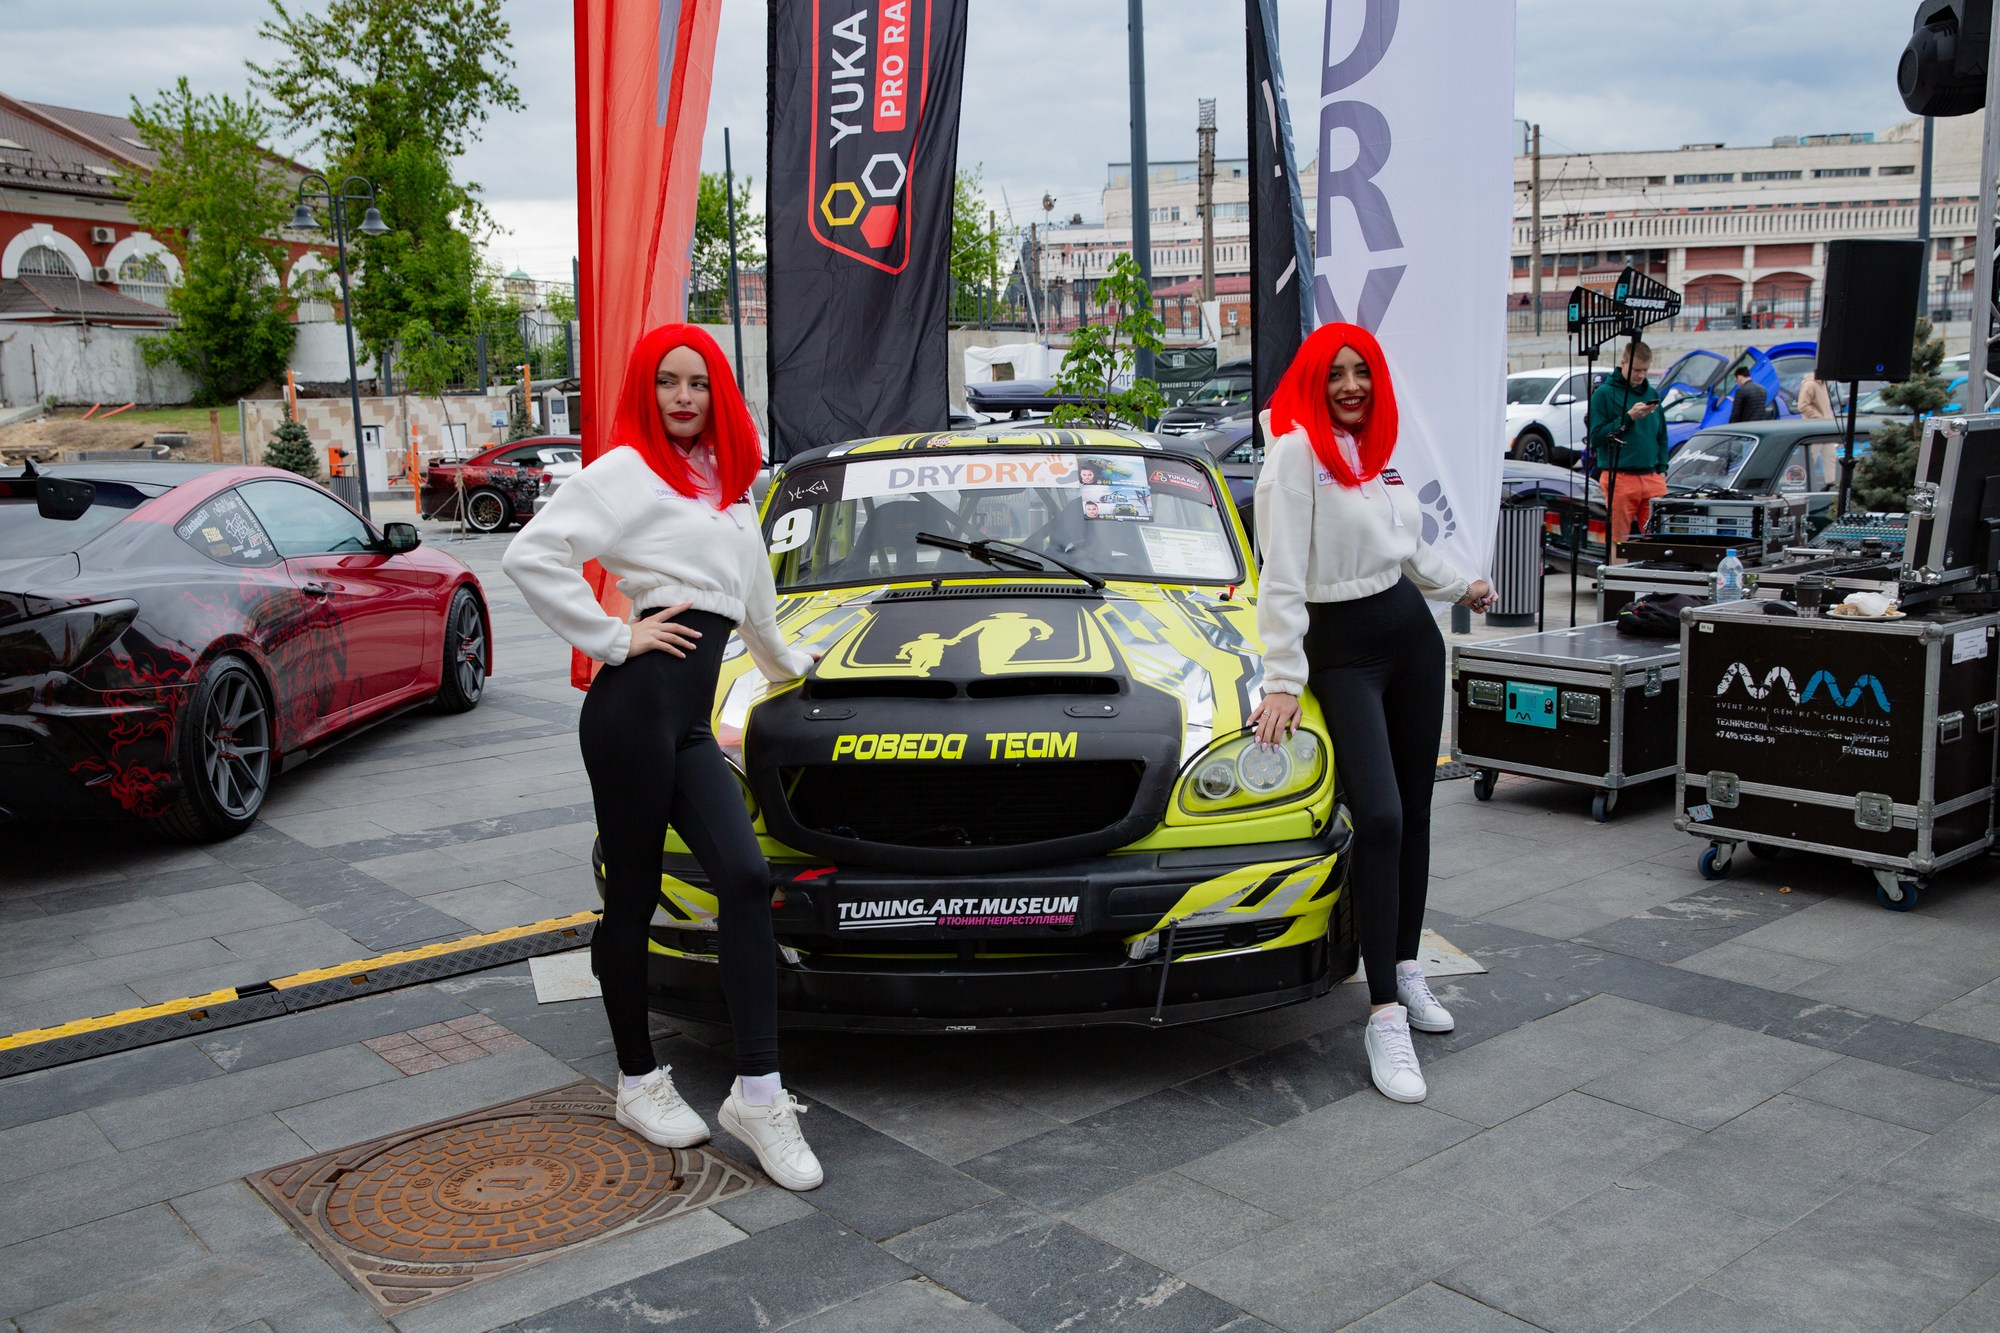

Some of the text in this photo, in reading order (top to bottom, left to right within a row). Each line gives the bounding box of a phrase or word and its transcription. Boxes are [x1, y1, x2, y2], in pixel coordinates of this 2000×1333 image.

[830, 9, 868, 149] YUKA
[880, 55, 904, 117] PRO
[1624, 297, 1667, 309] SHURE
[888, 462, 1042, 489] DRYDRY
[1167, 473, 1185, 482] YUKA
[769, 508, 813, 553] 9
[832, 731, 1078, 761] POBEDA TEAM
[838, 896, 1079, 919] TUNING.ART.MUSEUM
[938, 915, 1075, 926] #ТЮНИНГНЕПРЕСТУПЛЕНИЕ
